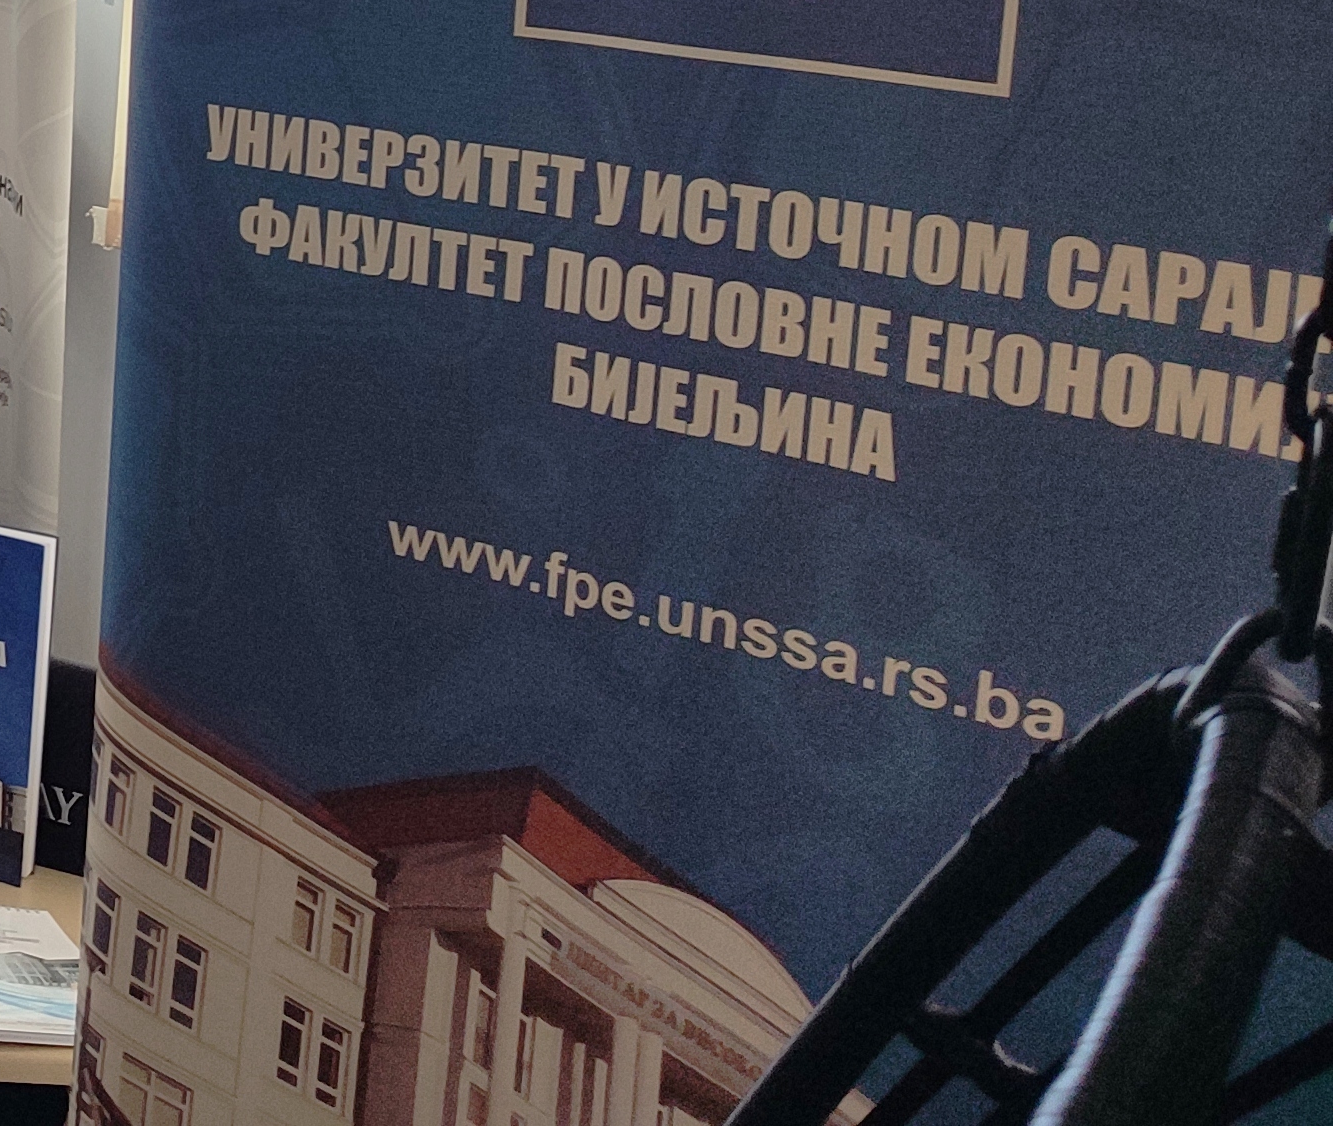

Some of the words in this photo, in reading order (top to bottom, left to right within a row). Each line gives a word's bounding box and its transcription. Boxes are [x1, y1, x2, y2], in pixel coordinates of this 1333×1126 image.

[207, 103, 586, 218] УНИВЕРЗИТЕТ
[594, 161, 630, 227] У
[640, 169, 1029, 300] ИСТОЧНОМ
[238, 198, 535, 303] ФАКУЛТЕТ
[544, 246, 892, 377] ПОСЛОВНЕ
[552, 342, 896, 482] БИЈЕЉИНА
[388, 520, 1065, 741] www.fpe.unssa.rs.ba
